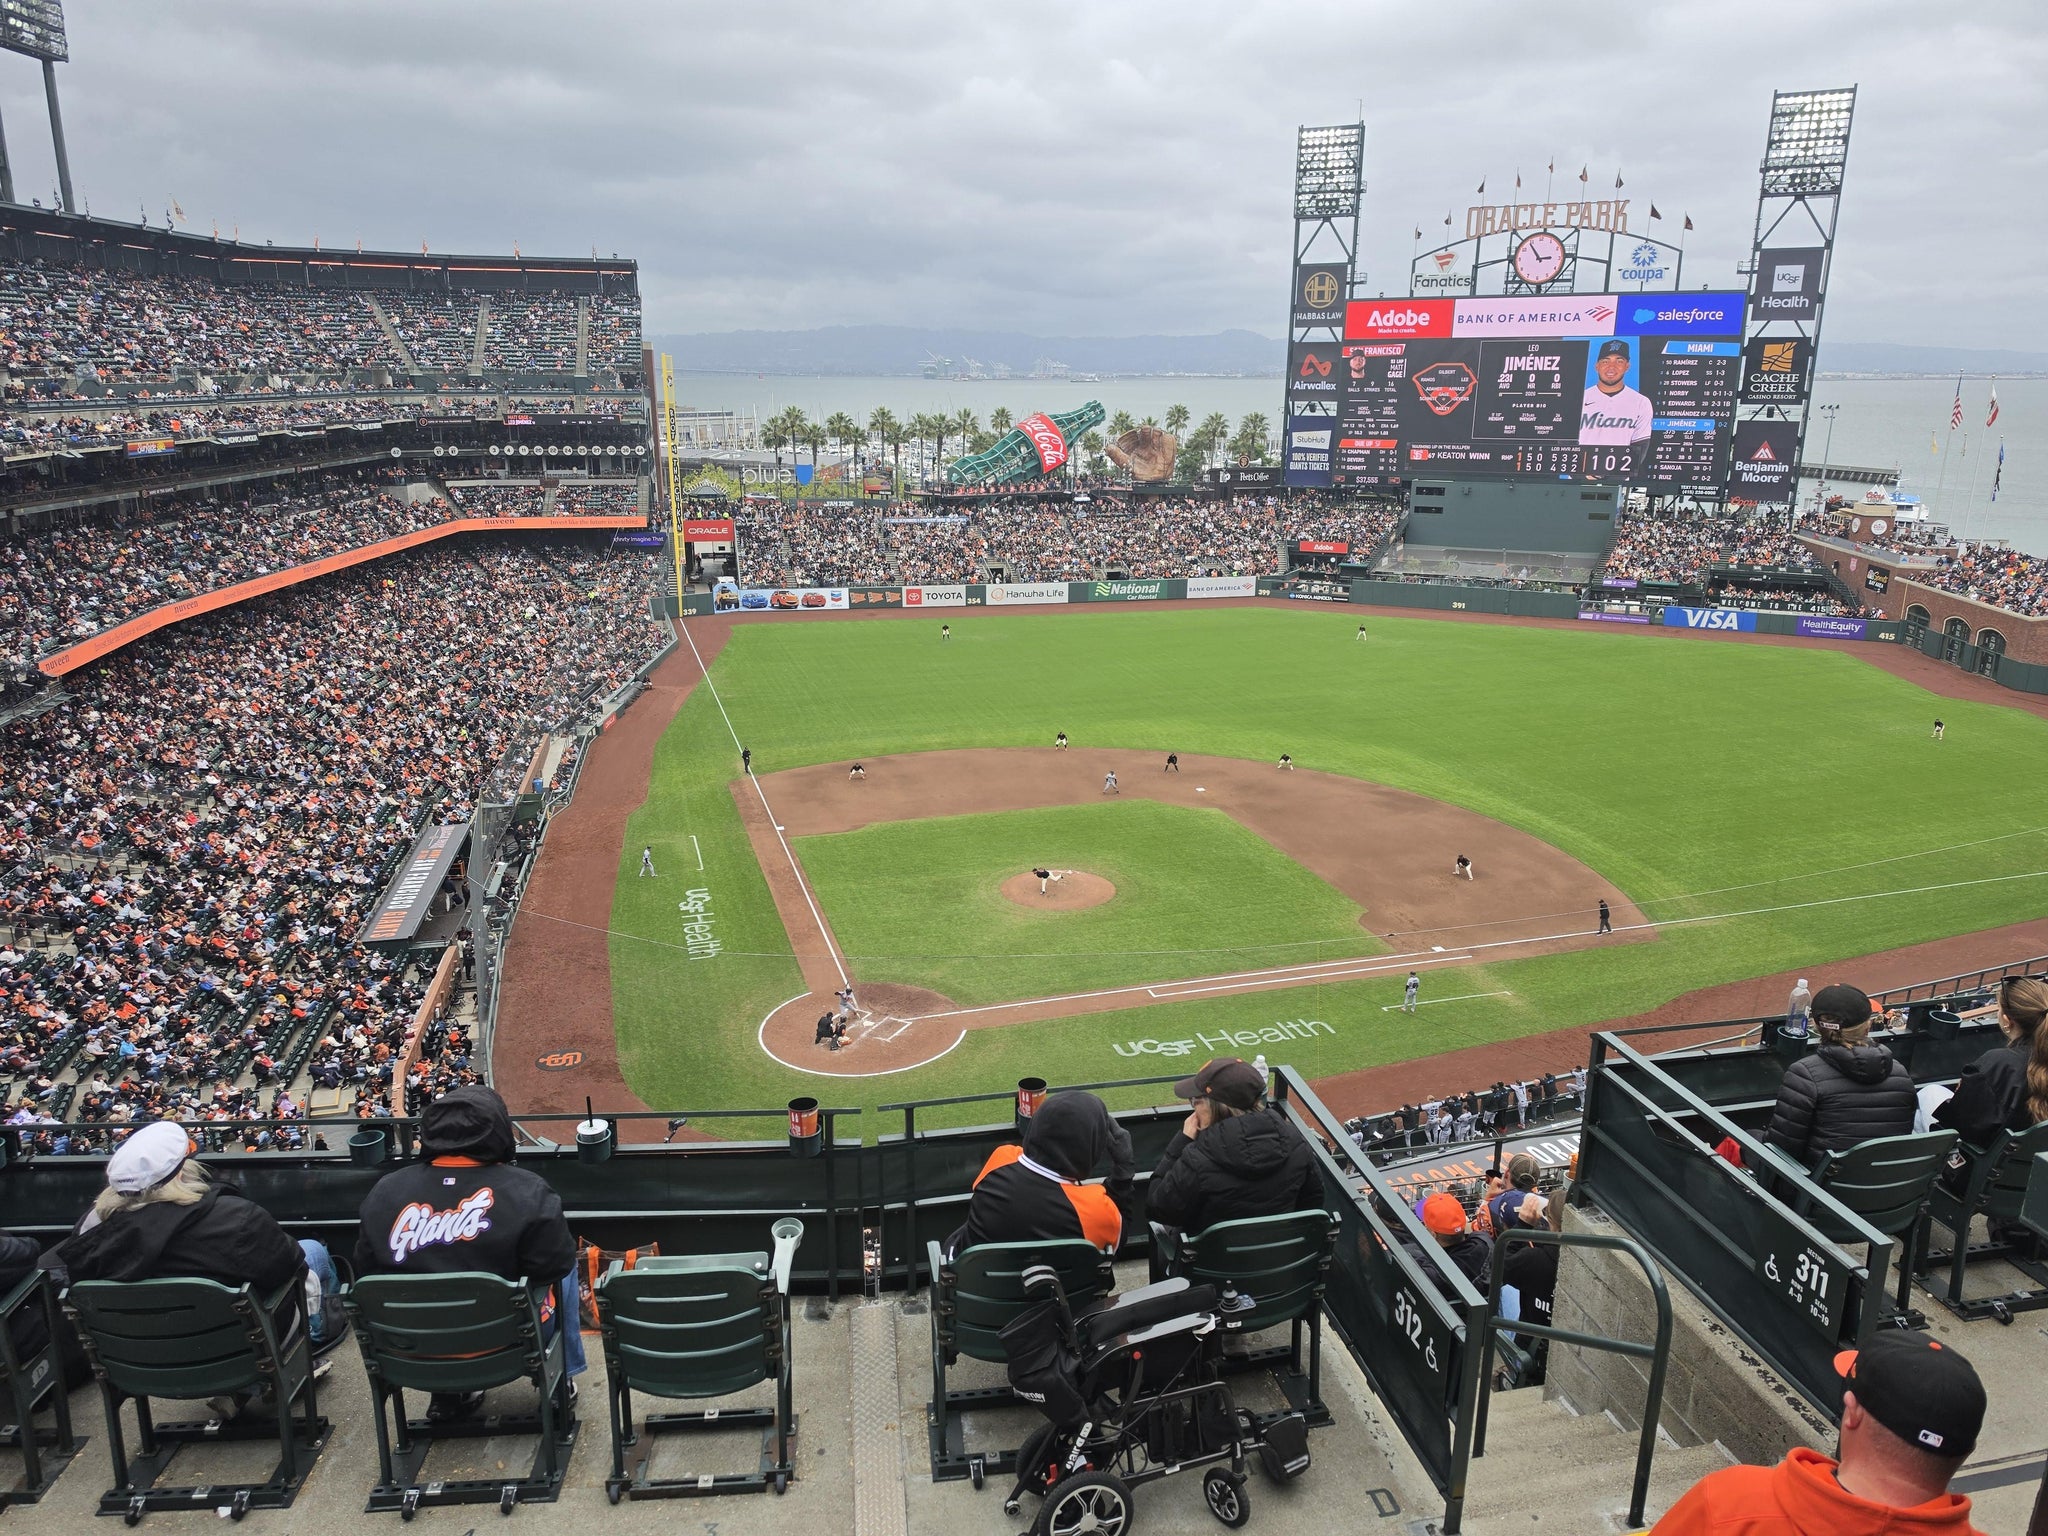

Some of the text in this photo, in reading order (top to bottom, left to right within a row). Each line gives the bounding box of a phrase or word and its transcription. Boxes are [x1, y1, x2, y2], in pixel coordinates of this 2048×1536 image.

[1466, 200, 1630, 240] ORACLE PARK
[1414, 274, 1470, 288] Fanatics
[1621, 268, 1664, 282] coupa
[1777, 273, 1800, 284] UCSF
[1761, 296, 1809, 308] Health
[1327, 312, 1342, 320] LAW
[1367, 310, 1430, 327] Adobe
[1458, 312, 1582, 324] BANK OF AMERICA
[1657, 308, 1724, 324] salesforce
[1364, 346, 1401, 355] FRANCISCO
[1687, 344, 1714, 353] MIAMI
[1503, 354, 1560, 373] JIMÉNEZ
[1529, 374, 1560, 382] 0 0
[1750, 374, 1799, 383] CACHE
[1294, 381, 1336, 390] Airwallex
[1750, 384, 1796, 393] CREEK
[1580, 412, 1640, 431] Miami
[1306, 453, 1329, 461] VERIFIED
[1527, 453, 1532, 462] 5
[1537, 453, 1542, 462] 0
[1552, 453, 1557, 462] 5
[1562, 454, 1567, 462] 3
[1572, 454, 1578, 462] 2
[1605, 456, 1631, 472] 0 2
[1290, 462, 1329, 470] GIANTS TICKETS
[1526, 463, 1531, 472] 5
[1536, 463, 1541, 472] 0
[1550, 463, 1556, 472] 4
[1561, 463, 1566, 472] 3
[1571, 463, 1577, 472] 2
[1735, 461, 1789, 473] Benjamin
[743, 464, 792, 484] blue
[1254, 472, 1269, 481] Coffee
[1741, 472, 1780, 483] Moore
[1730, 496, 1758, 506] Coors
[1866, 492, 1885, 500] Coors
[1006, 588, 1064, 599] Hanwha Life
[1109, 582, 1160, 595] National
[926, 592, 962, 600] TOYOTA
[174, 600, 198, 614] nuveen
[1682, 609, 1738, 630] VISA
[1803, 619, 1862, 632] HealthEquity
[1879, 632, 1895, 640] 415
[45, 654, 69, 672] nuveen
[410, 859, 436, 873] SAN
[387, 873, 427, 909] FRANCISCO
[369, 911, 406, 938] GIANTS
[679, 888, 724, 960] UCSF Health
[1112, 1018, 1336, 1057] UCSF Health
[389, 1187, 494, 1264] Giants
[1807, 1247, 1825, 1266] SECTION
[1796, 1253, 1829, 1299] 311
[1791, 1278, 1804, 1293] ROWS
[1788, 1286, 1802, 1303] A-D
[1815, 1298, 1828, 1313] SEATS
[1395, 1291, 1422, 1350] 312
[1810, 1304, 1829, 1326] 10-19
[1365, 1488, 1401, 1518] D
